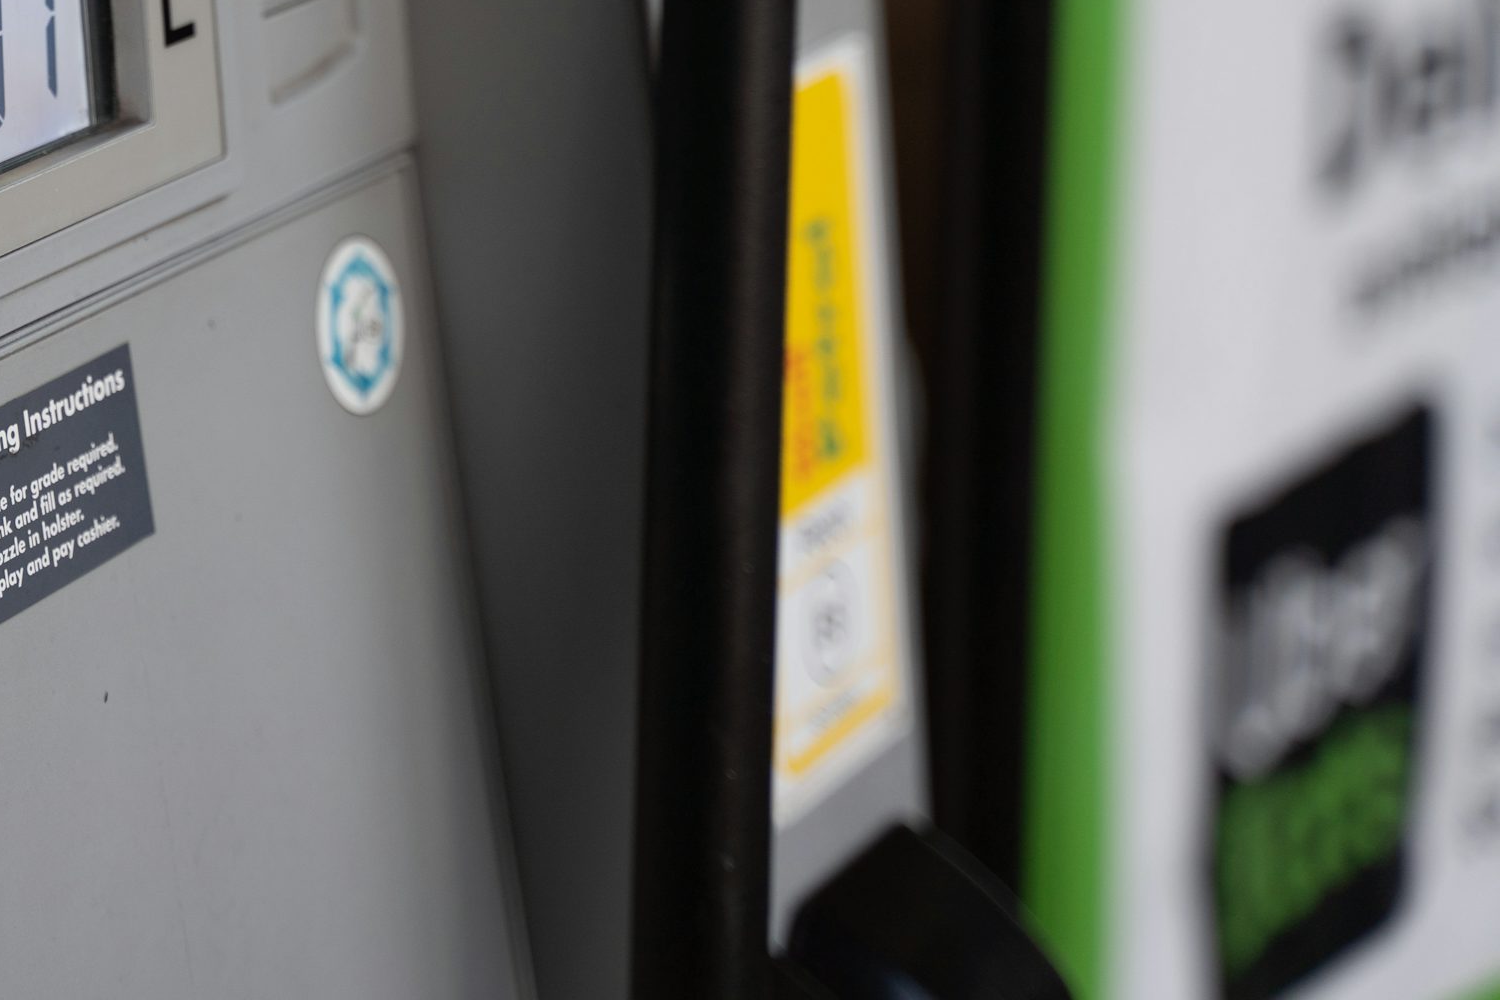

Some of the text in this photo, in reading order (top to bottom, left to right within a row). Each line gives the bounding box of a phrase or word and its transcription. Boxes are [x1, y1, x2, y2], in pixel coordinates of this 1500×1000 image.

[23, 369, 126, 438] Instructions
[10, 484, 28, 506] for
[30, 462, 65, 499] grade
[67, 432, 119, 479] required.
[15, 500, 38, 531] and
[40, 490, 56, 515] fill
[58, 487, 72, 506] as
[74, 455, 125, 502] required.
[27, 547, 50, 578] and
[53, 540, 75, 567] pay
[77, 513, 120, 548] cashier.
[28, 528, 40, 548] in
[42, 507, 85, 540] holster.
